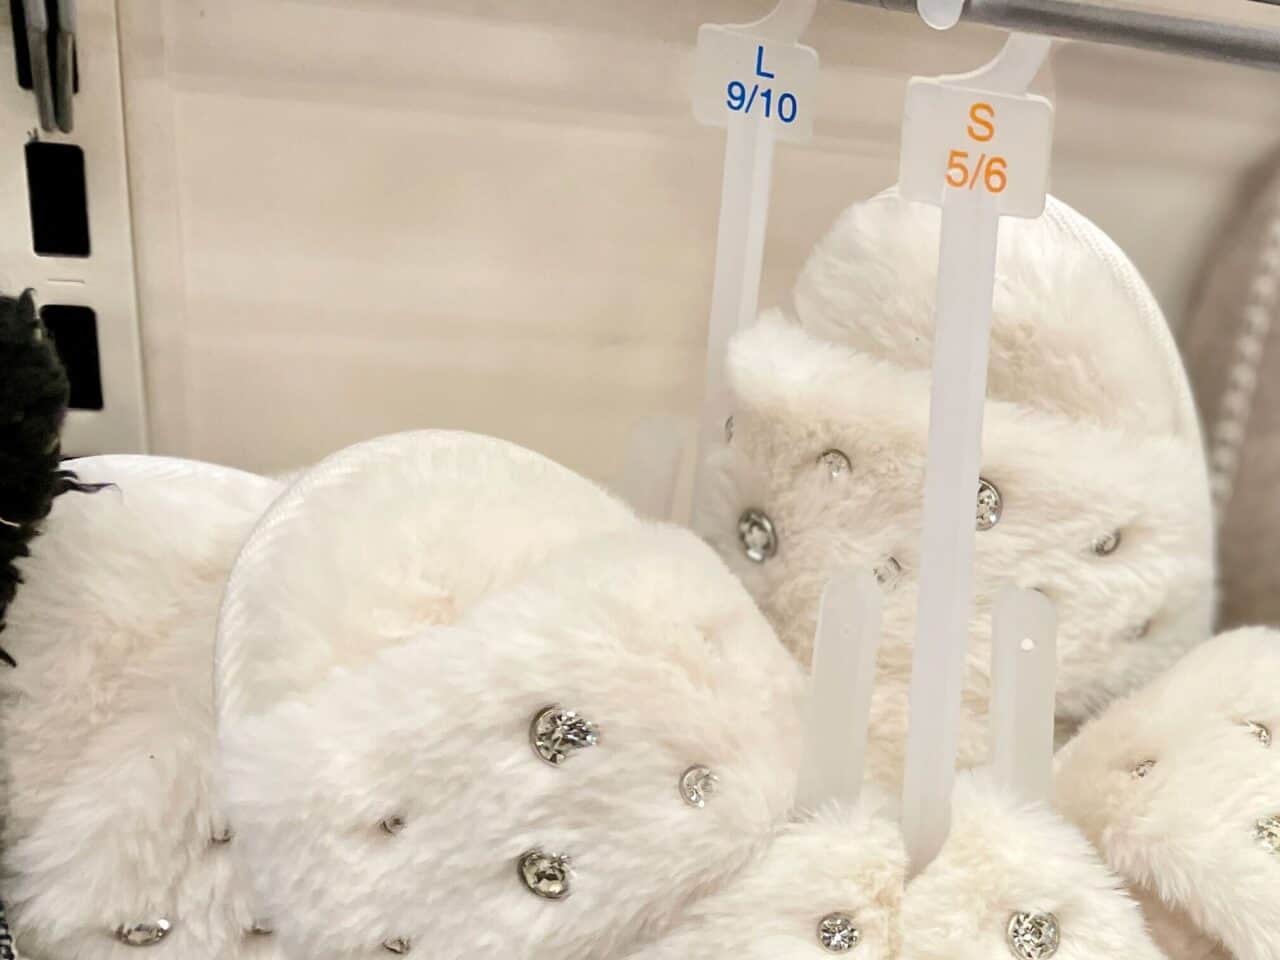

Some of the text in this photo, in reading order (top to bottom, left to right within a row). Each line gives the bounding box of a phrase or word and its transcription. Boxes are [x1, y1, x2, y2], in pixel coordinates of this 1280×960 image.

[755, 45, 775, 79] L
[726, 80, 798, 123] 9/10
[967, 102, 995, 142] S
[944, 149, 1008, 193] 5/6
